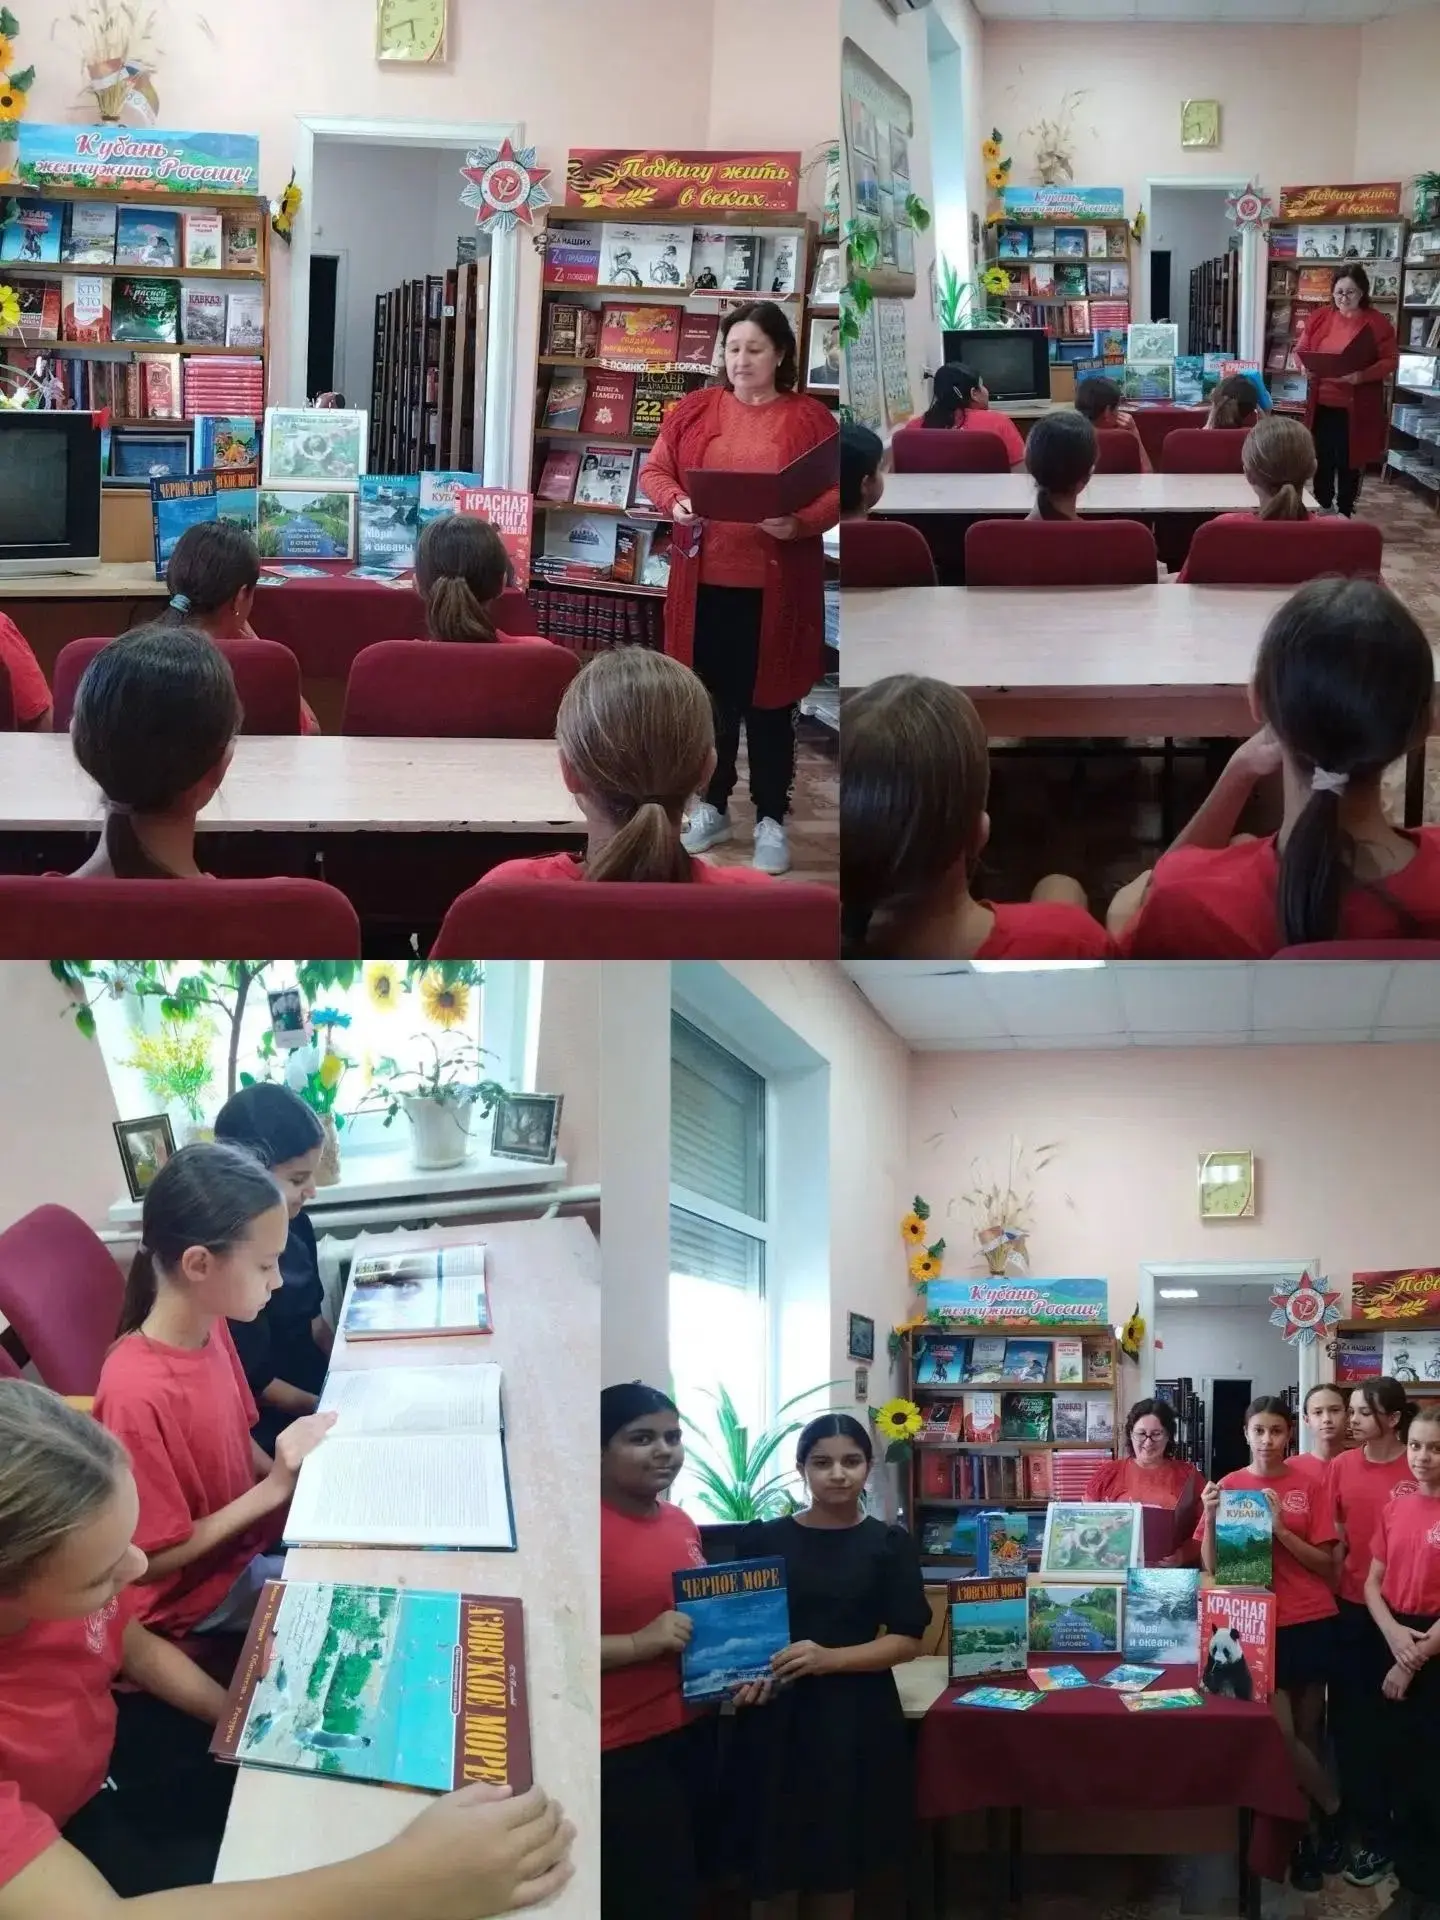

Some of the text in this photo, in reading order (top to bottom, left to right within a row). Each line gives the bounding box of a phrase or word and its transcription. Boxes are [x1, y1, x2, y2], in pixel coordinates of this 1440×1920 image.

[76, 132, 167, 161] Кубань
[35, 157, 252, 183] жемчужина России!
[615, 156, 715, 184] Подвигу
[680, 187, 697, 206] в
[1306, 189, 1355, 201] Подвигу
[561, 237, 592, 246] НАШИХ
[640, 372, 685, 384] ИСАЕВ
[591, 391, 625, 400] ПАМЯТИ
[595, 385, 619, 393] КНИГА
[636, 400, 662, 416] 22
[160, 479, 213, 499] ЧЕРНОЕ МОРЕ
[465, 492, 529, 513] КРАСНАЯ
[488, 511, 528, 527] КНИГА
[364, 527, 393, 540] Моря
[501, 525, 528, 535] ЗЕМЛИ
[374, 543, 413, 552] океаны
[969, 1284, 1039, 1302] Кубань
[939, 1299, 1103, 1317] жемчужина России!
[1226, 1509, 1265, 1518] КУБАНИ
[681, 1567, 780, 1599] ЧЕРНОЕ МОРЕ
[956, 1582, 1024, 1601] АЗОВСКОЕ МОРЕ
[1206, 1595, 1268, 1619] КРАСНАЯ
[1130, 1622, 1158, 1635] Моря
[1228, 1616, 1266, 1635] КНИГА
[1129, 1638, 1178, 1648] и океаны
[1240, 1633, 1266, 1645] ЗЕМЛИ
[463, 1603, 508, 1785] АЗОВСКОЕ МОРЕ
